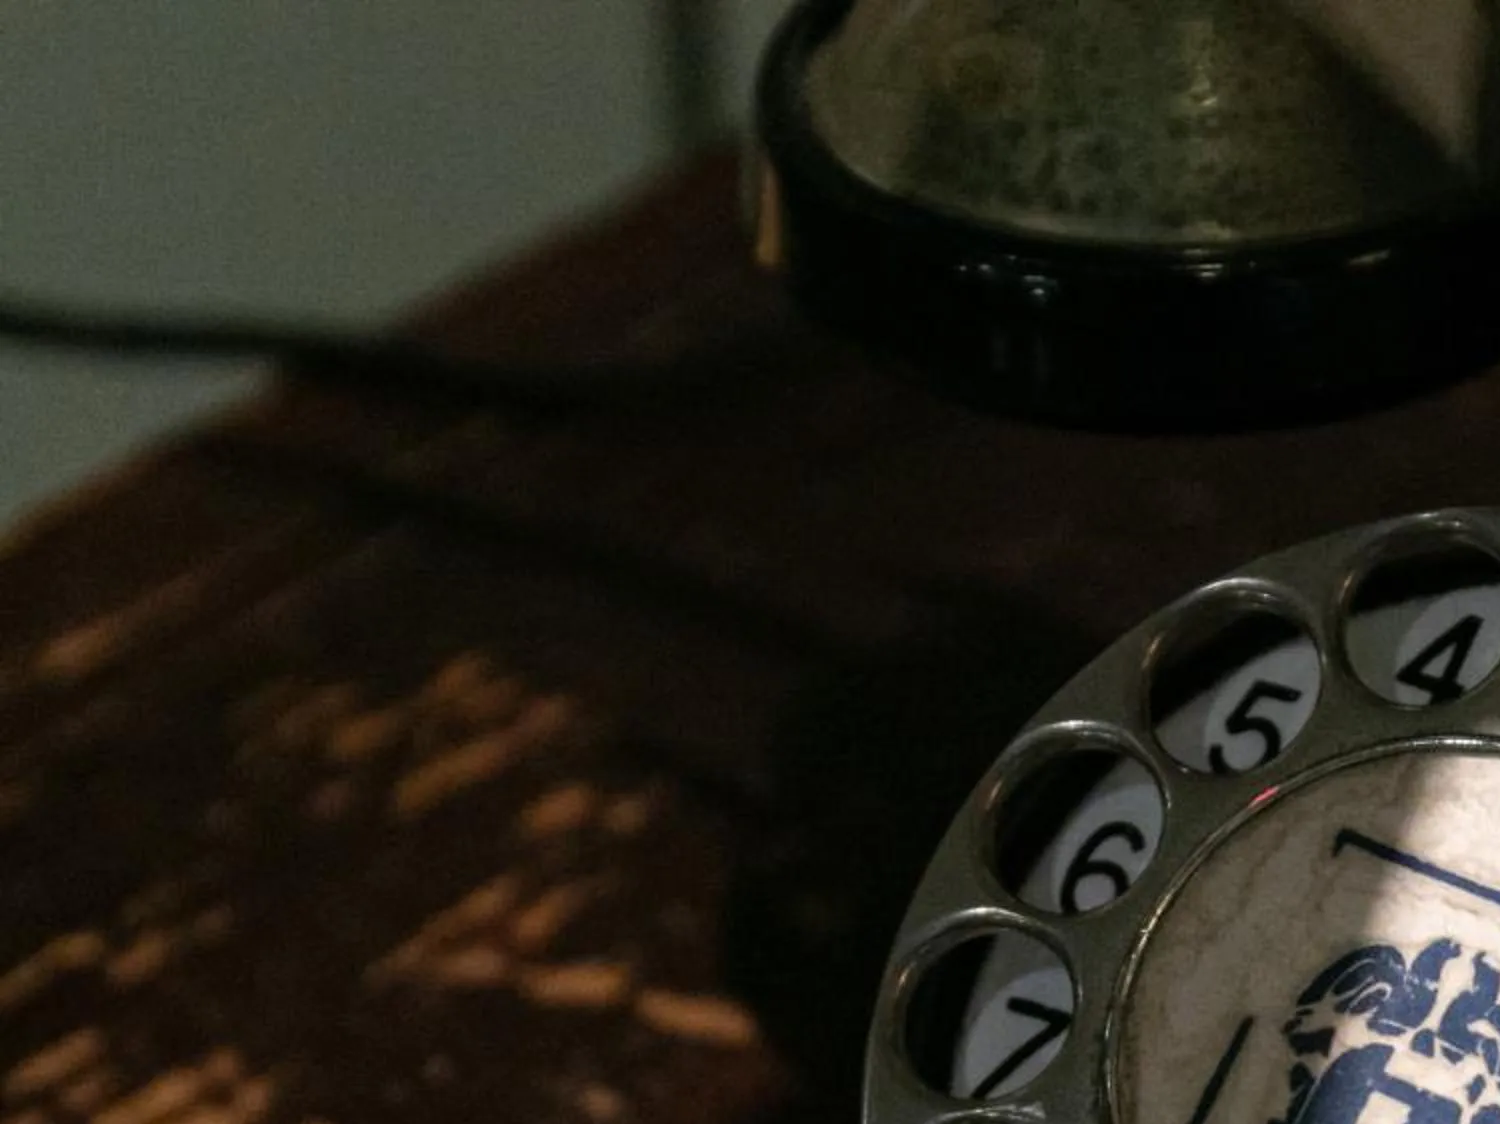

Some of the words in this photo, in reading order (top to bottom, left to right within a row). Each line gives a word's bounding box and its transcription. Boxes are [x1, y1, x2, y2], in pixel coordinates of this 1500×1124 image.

[1396, 615, 1483, 704] 4
[1209, 680, 1301, 774] 5
[1061, 821, 1145, 916] 6
[971, 997, 1073, 1098] 7
